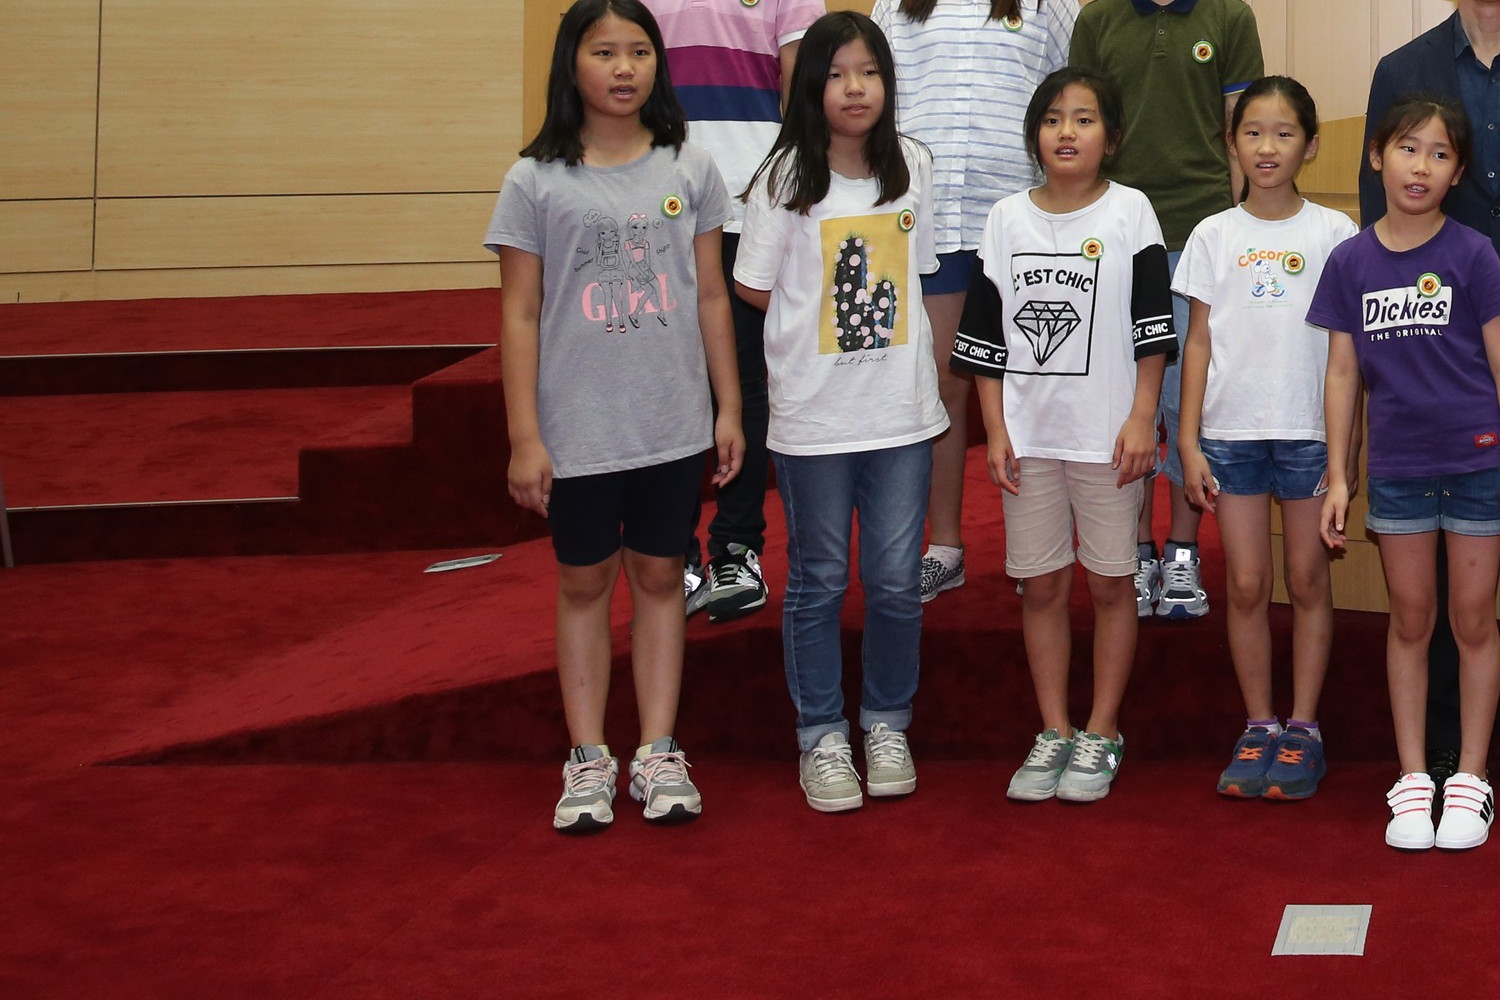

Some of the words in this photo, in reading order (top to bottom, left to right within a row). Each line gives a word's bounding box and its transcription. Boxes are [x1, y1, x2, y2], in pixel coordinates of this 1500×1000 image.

[1055, 269, 1094, 293] CHIC
[1366, 293, 1447, 325] Dickies
[1144, 323, 1169, 336] CHIC
[1370, 332, 1390, 341] THE
[1396, 327, 1442, 337] ORIGINAL
[969, 345, 991, 359] CHIC
